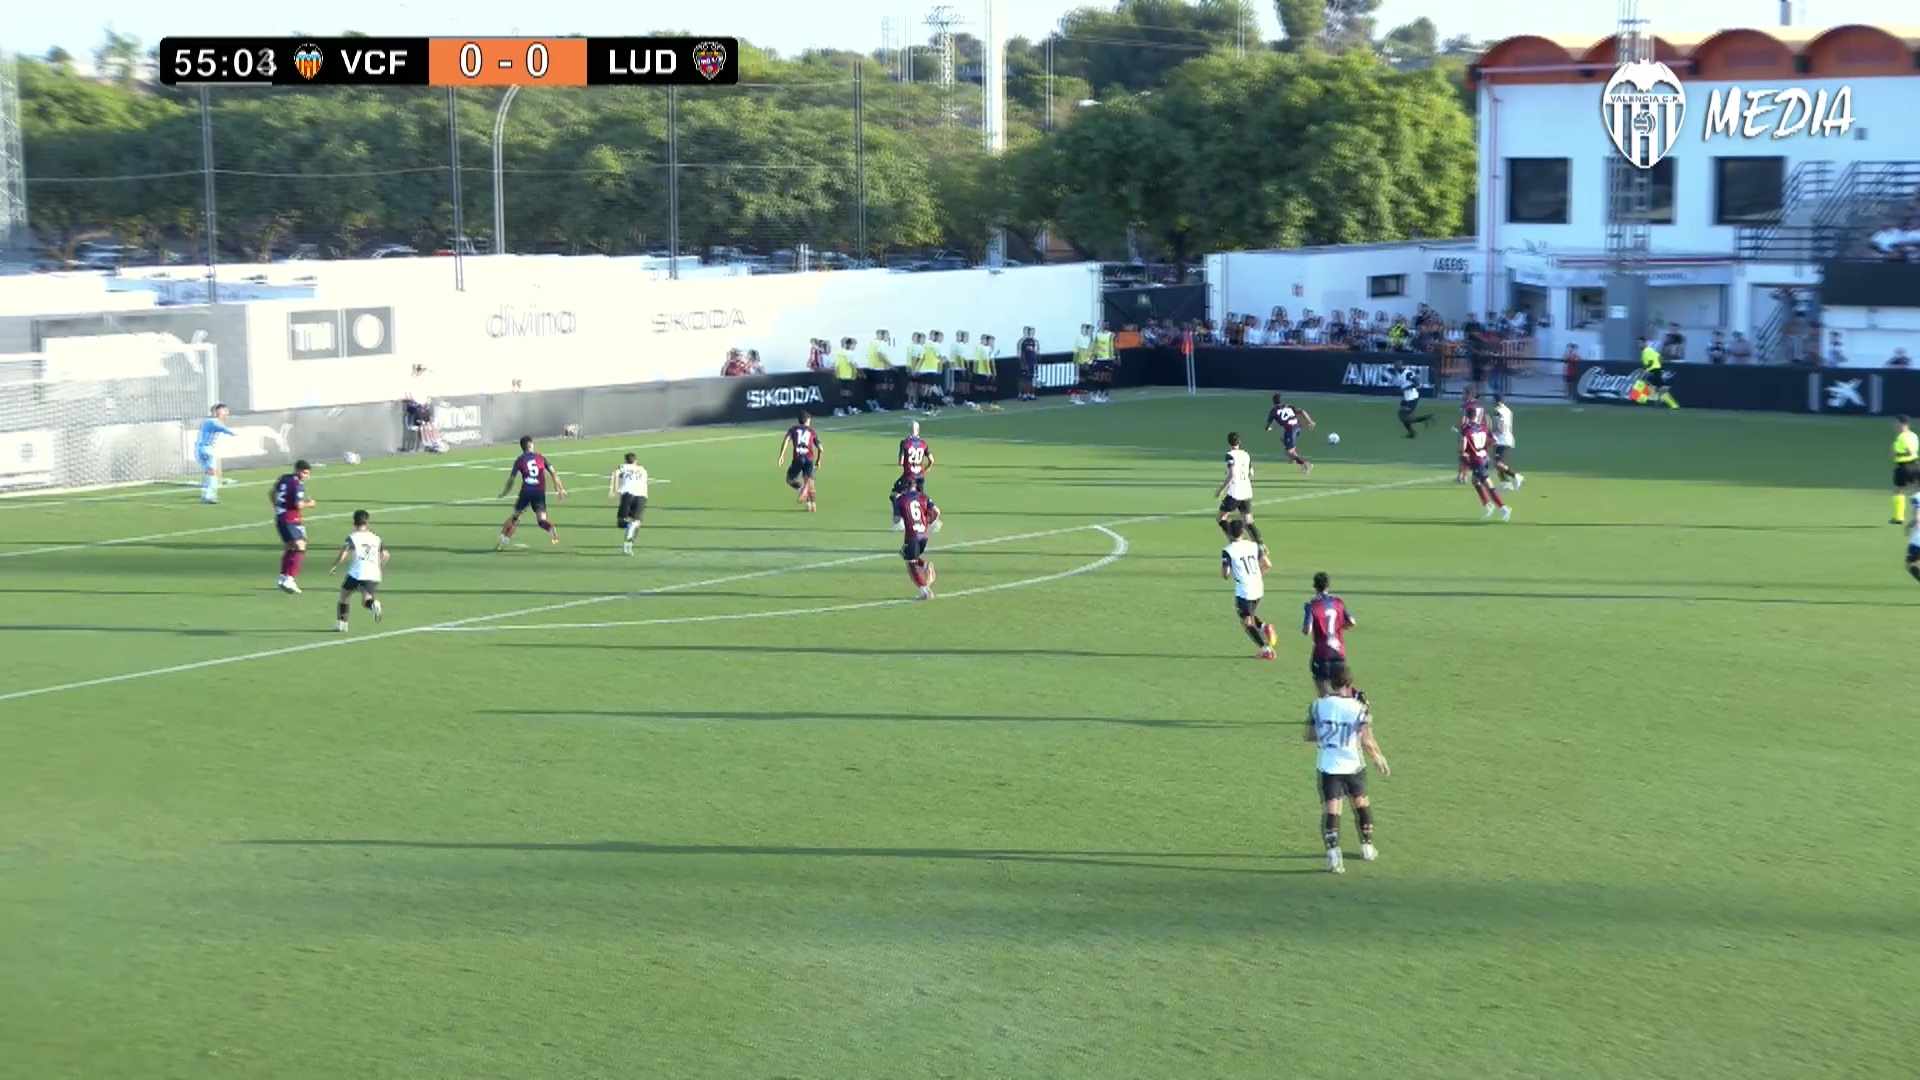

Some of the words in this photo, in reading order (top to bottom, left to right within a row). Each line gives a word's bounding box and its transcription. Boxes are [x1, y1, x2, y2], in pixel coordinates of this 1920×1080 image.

[745, 385, 825, 409] SKODA
[796, 429, 811, 446] 14
[908, 447, 924, 465] 20
[526, 459, 540, 477] 5
[909, 499, 922, 521] 6
